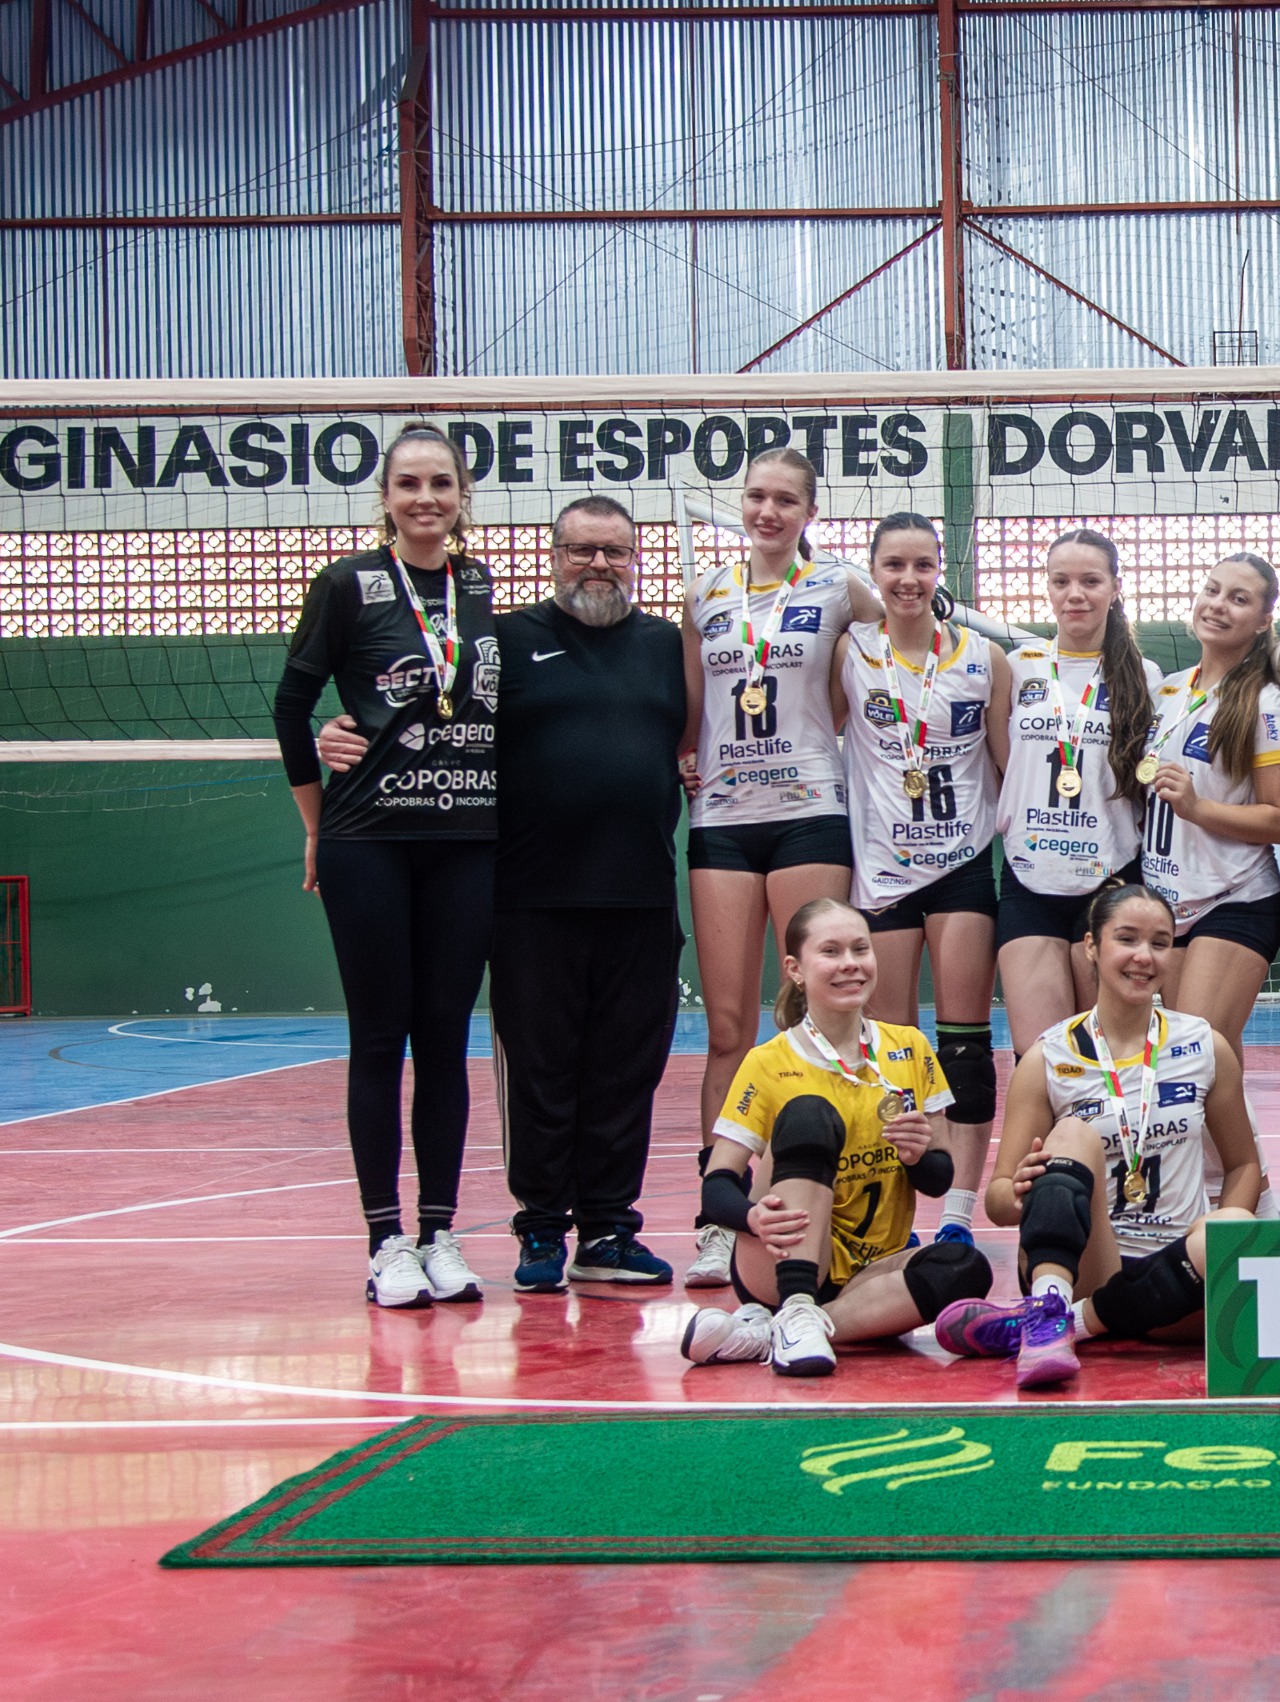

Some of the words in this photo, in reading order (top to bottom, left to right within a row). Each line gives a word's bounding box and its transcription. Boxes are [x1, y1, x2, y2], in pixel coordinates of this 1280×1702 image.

[1, 420, 380, 489] GINASIO
[448, 420, 534, 483] DE
[558, 413, 929, 482] ESPORTES
[428, 724, 495, 747] cegero
[719, 738, 793, 760] Plastlife
[738, 766, 799, 786] cegero
[903, 765, 957, 822] 16
[1026, 808, 1098, 829] Plastlife
[1146, 791, 1175, 857] 10
[892, 820, 973, 840] Plastlife
[912, 846, 976, 868] cegero
[1038, 838, 1099, 856] cegero
